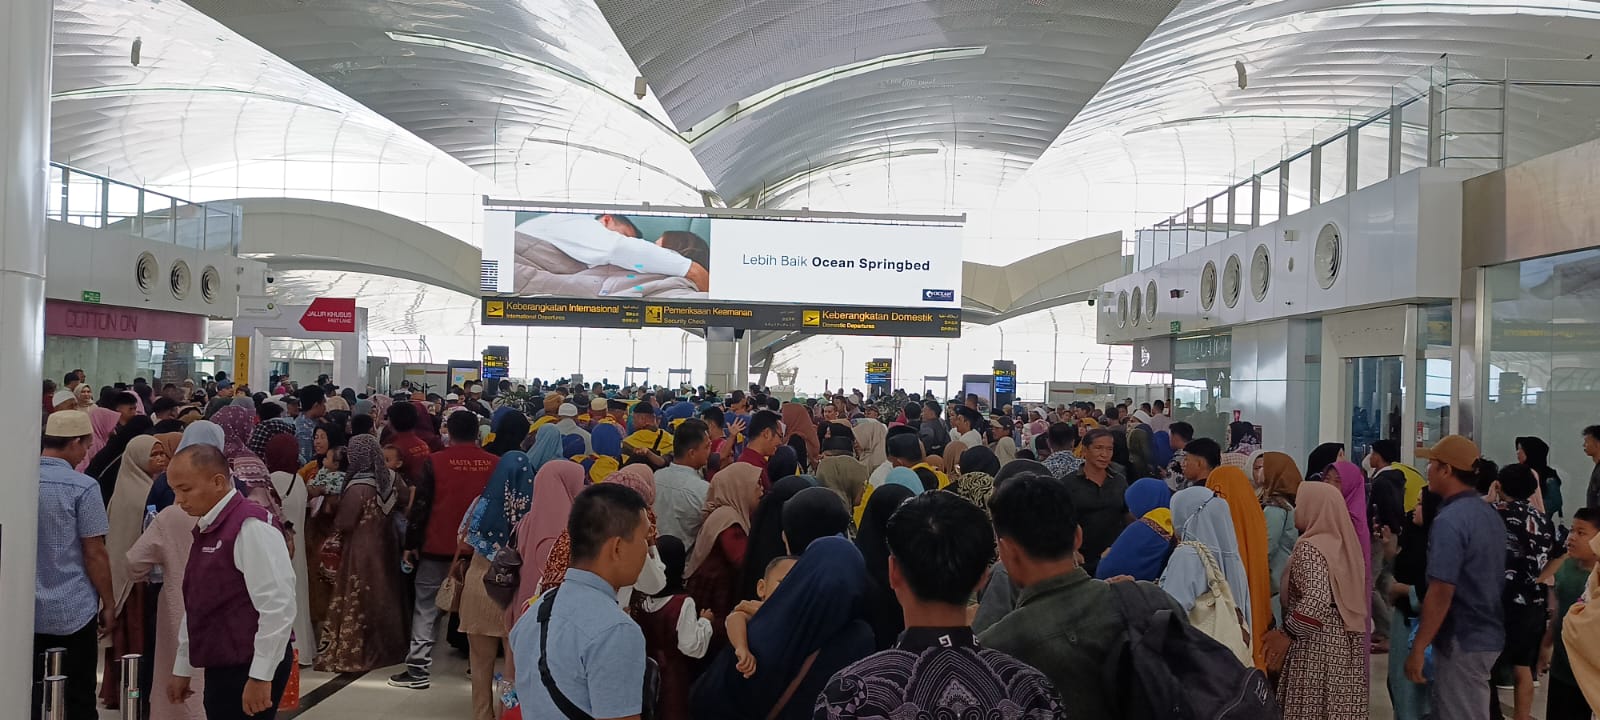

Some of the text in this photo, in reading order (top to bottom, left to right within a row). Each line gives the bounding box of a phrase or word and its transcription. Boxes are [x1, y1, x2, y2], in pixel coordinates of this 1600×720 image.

[742, 253, 930, 273] Lebih Baik Ocean Springbed
[506, 301, 567, 313] Keberangkatan
[569, 303, 620, 313] Internasional
[663, 306, 753, 317] Pemeriksaan Keamanan
[65, 309, 138, 333] COTTON ON
[663, 317, 687, 325] Security
[822, 310, 890, 322] Keberangkatan
[891, 312, 934, 322] Domestik
